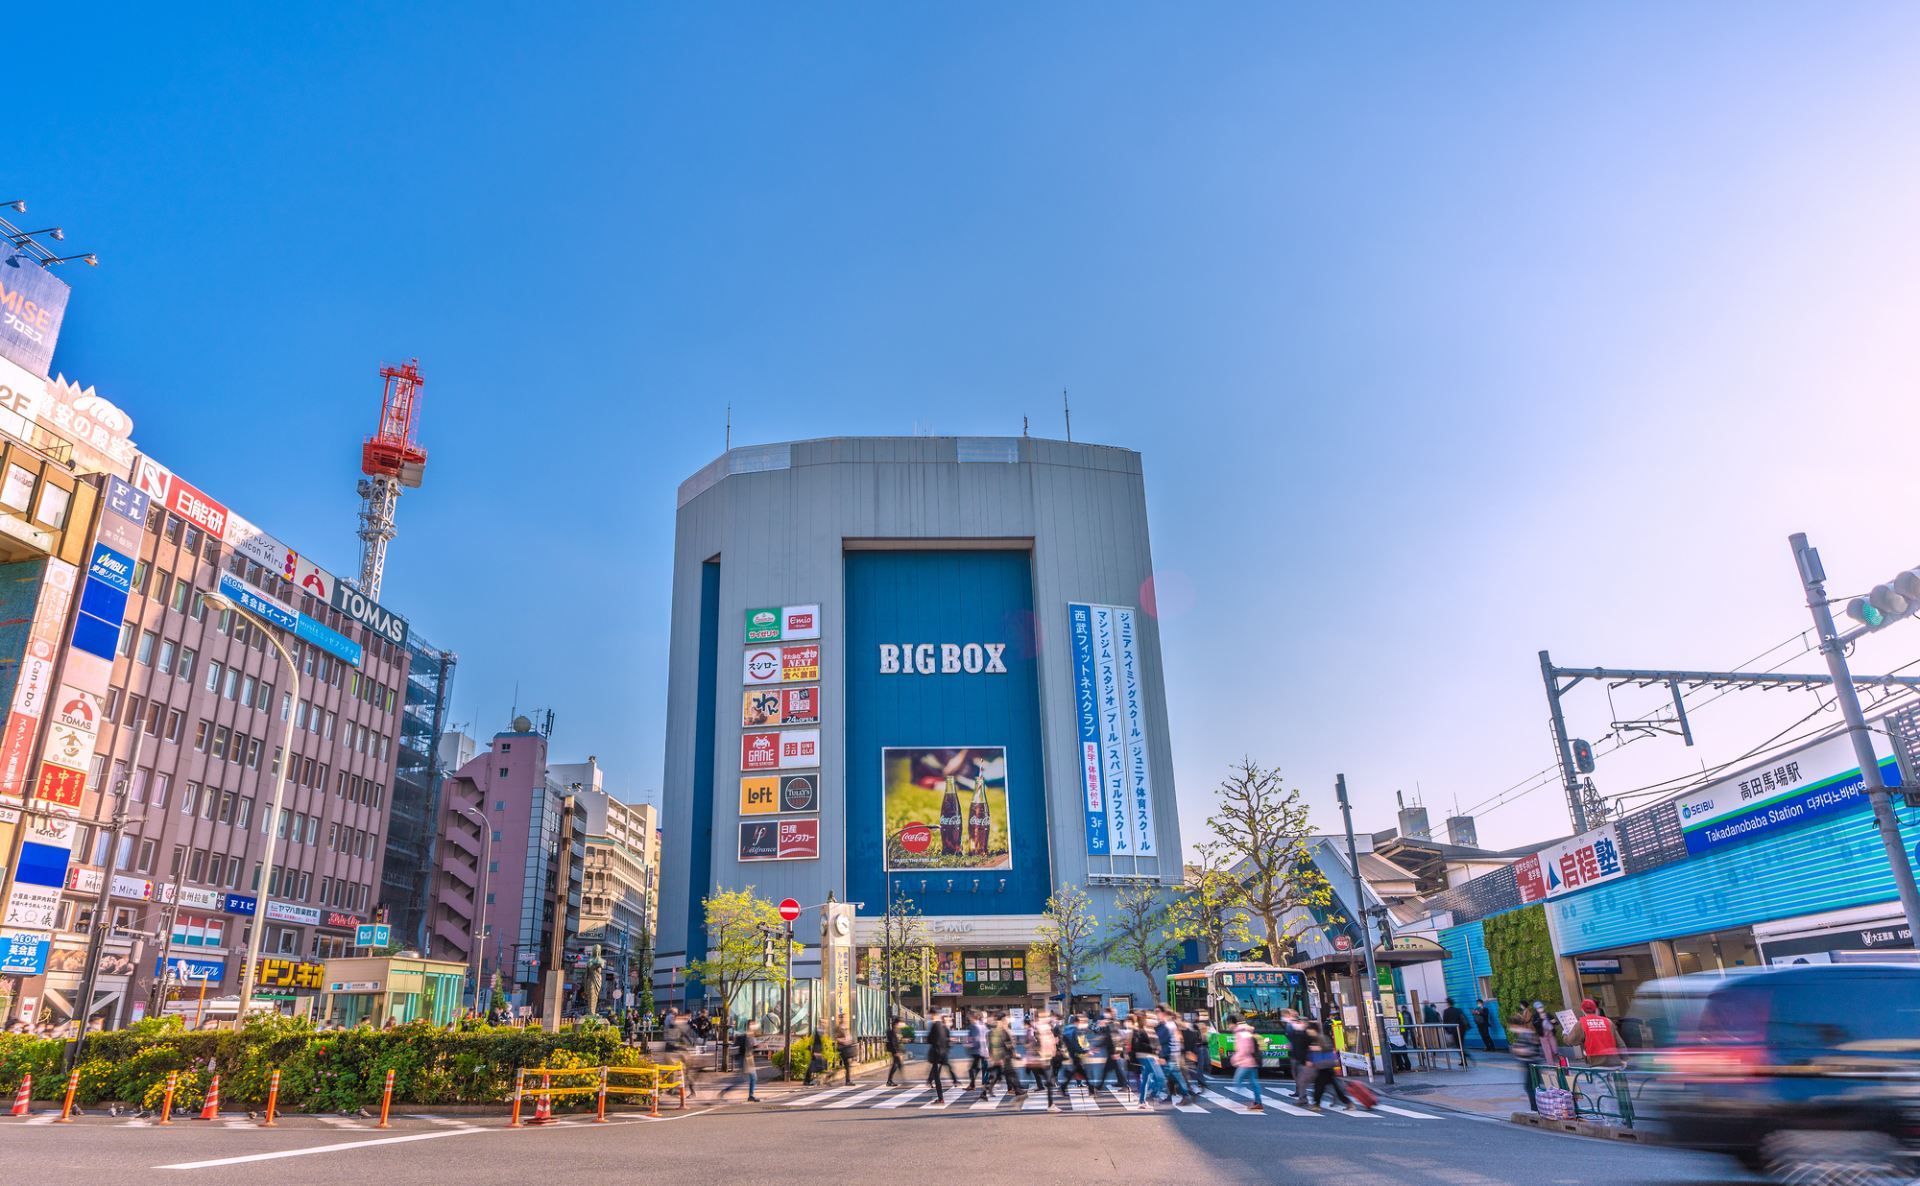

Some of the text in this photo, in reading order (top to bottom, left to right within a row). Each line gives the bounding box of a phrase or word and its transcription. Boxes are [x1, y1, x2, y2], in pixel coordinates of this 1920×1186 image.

[4, 312, 44, 344] プロミス
[176, 489, 224, 534] 日能研
[231, 520, 275, 553] コンタクトレンズ
[228, 530, 284, 569] Menicon Miru
[91, 564, 129, 587] 東急リバブル
[240, 592, 297, 629] 英会話イーオン
[341, 585, 403, 642] TOMAS
[790, 616, 812, 625] Emio
[748, 662, 778, 671] スシロー
[788, 659, 813, 668] NEXT
[879, 643, 1007, 675] BIG BOX
[31, 660, 42, 681] Can
[1074, 609, 1096, 737] 西武フィットネスクラブ
[24, 692, 35, 708] Do
[61, 713, 92, 730] TOMAS
[748, 749, 774, 763] GAME
[55, 769, 69, 802] 中本
[1738, 761, 1803, 801] 高田馬場駅
[1691, 800, 1714, 816] SEIBU
[781, 825, 797, 834] 日産
[1705, 804, 1804, 844] Takadanobaba Station
[781, 834, 815, 843] レンタカー
[119, 885, 138, 896] Miru
[13, 934, 39, 945] AEON
[8, 945, 38, 956] 英会話
[3, 956, 39, 966] イーオン
[1248, 973, 1283, 982] 早大正門
